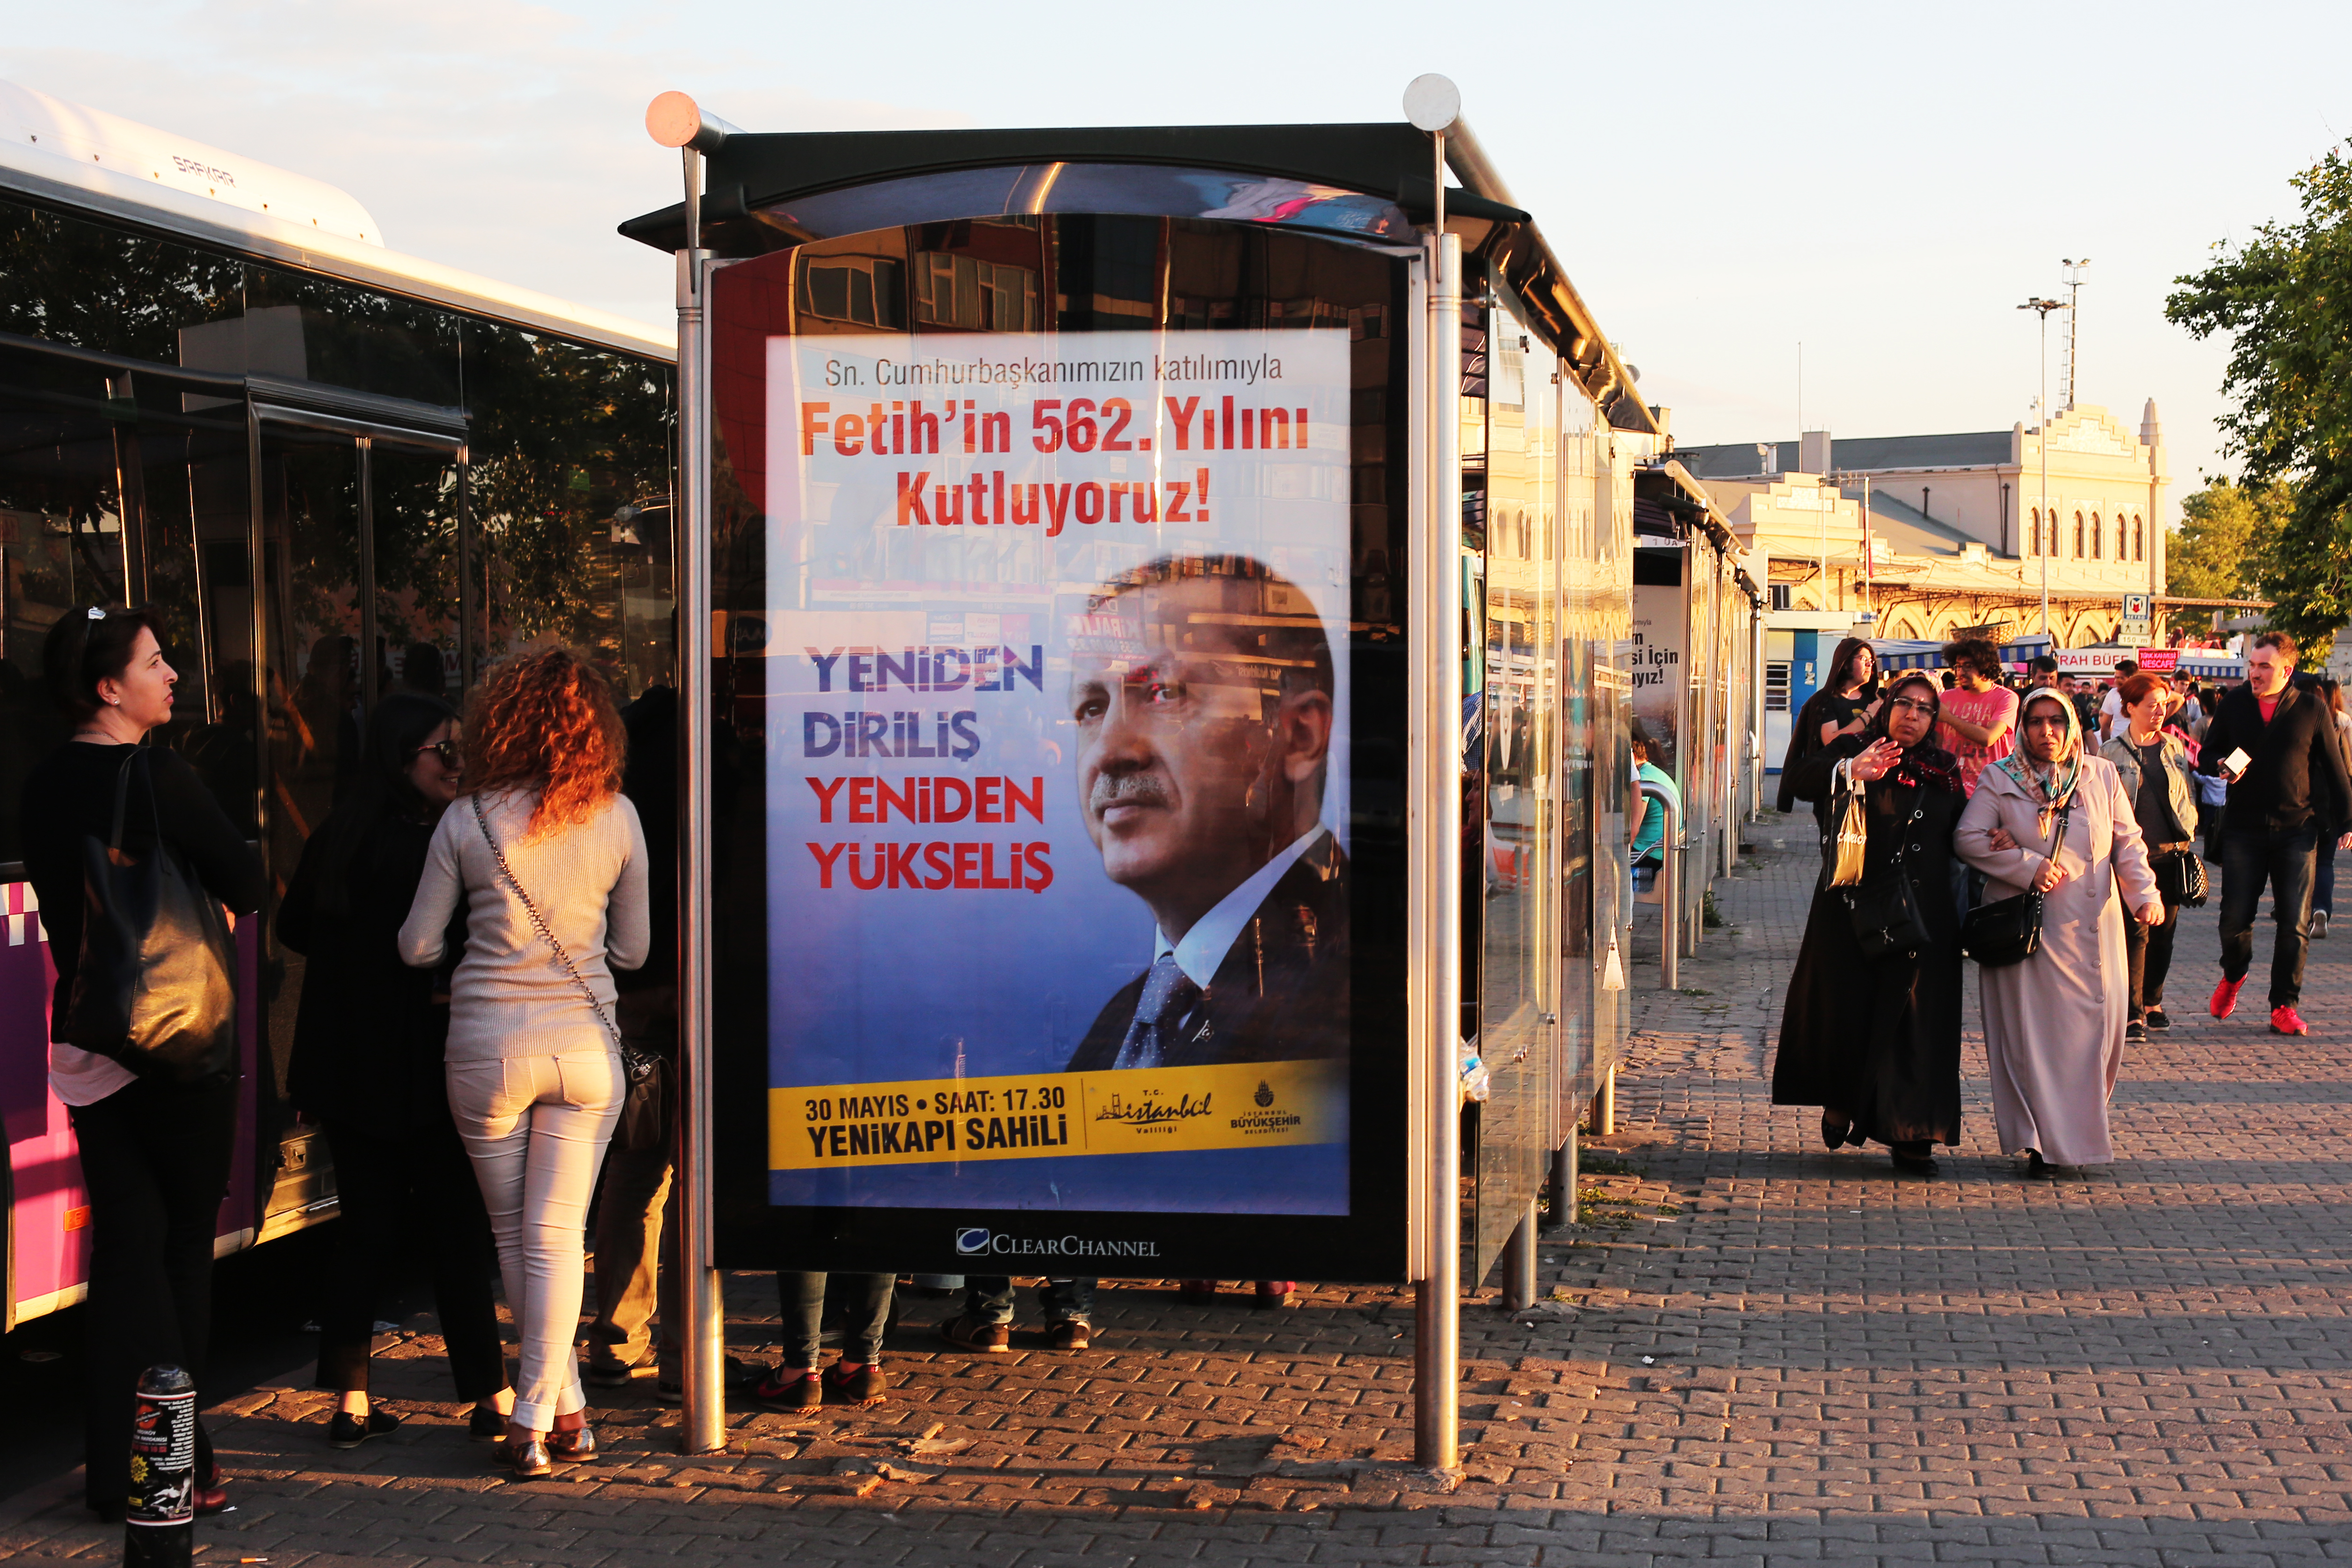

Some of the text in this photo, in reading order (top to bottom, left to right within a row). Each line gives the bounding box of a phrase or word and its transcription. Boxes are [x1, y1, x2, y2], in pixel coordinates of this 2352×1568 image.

[173, 155, 236, 188] SAFKAR
[826, 352, 1282, 390] Sn. Cumhurbaşkanımızın katılımıyla
[802, 395, 1308, 457] Fetih'in 562. Yılını
[896, 468, 1210, 537] Kutluyoruz!
[1648, 644, 1678, 668] İçin
[2141, 660, 2175, 668] NESCAFE
[806, 1086, 1065, 1121] 30 MAYIS SAAT: 17.30
[1136, 1125, 1177, 1135] Valiliği
[1230, 1114, 1301, 1129] BÜYÜKŞEHİR
[1244, 1127, 1289, 1135] BELEDİYESİ
